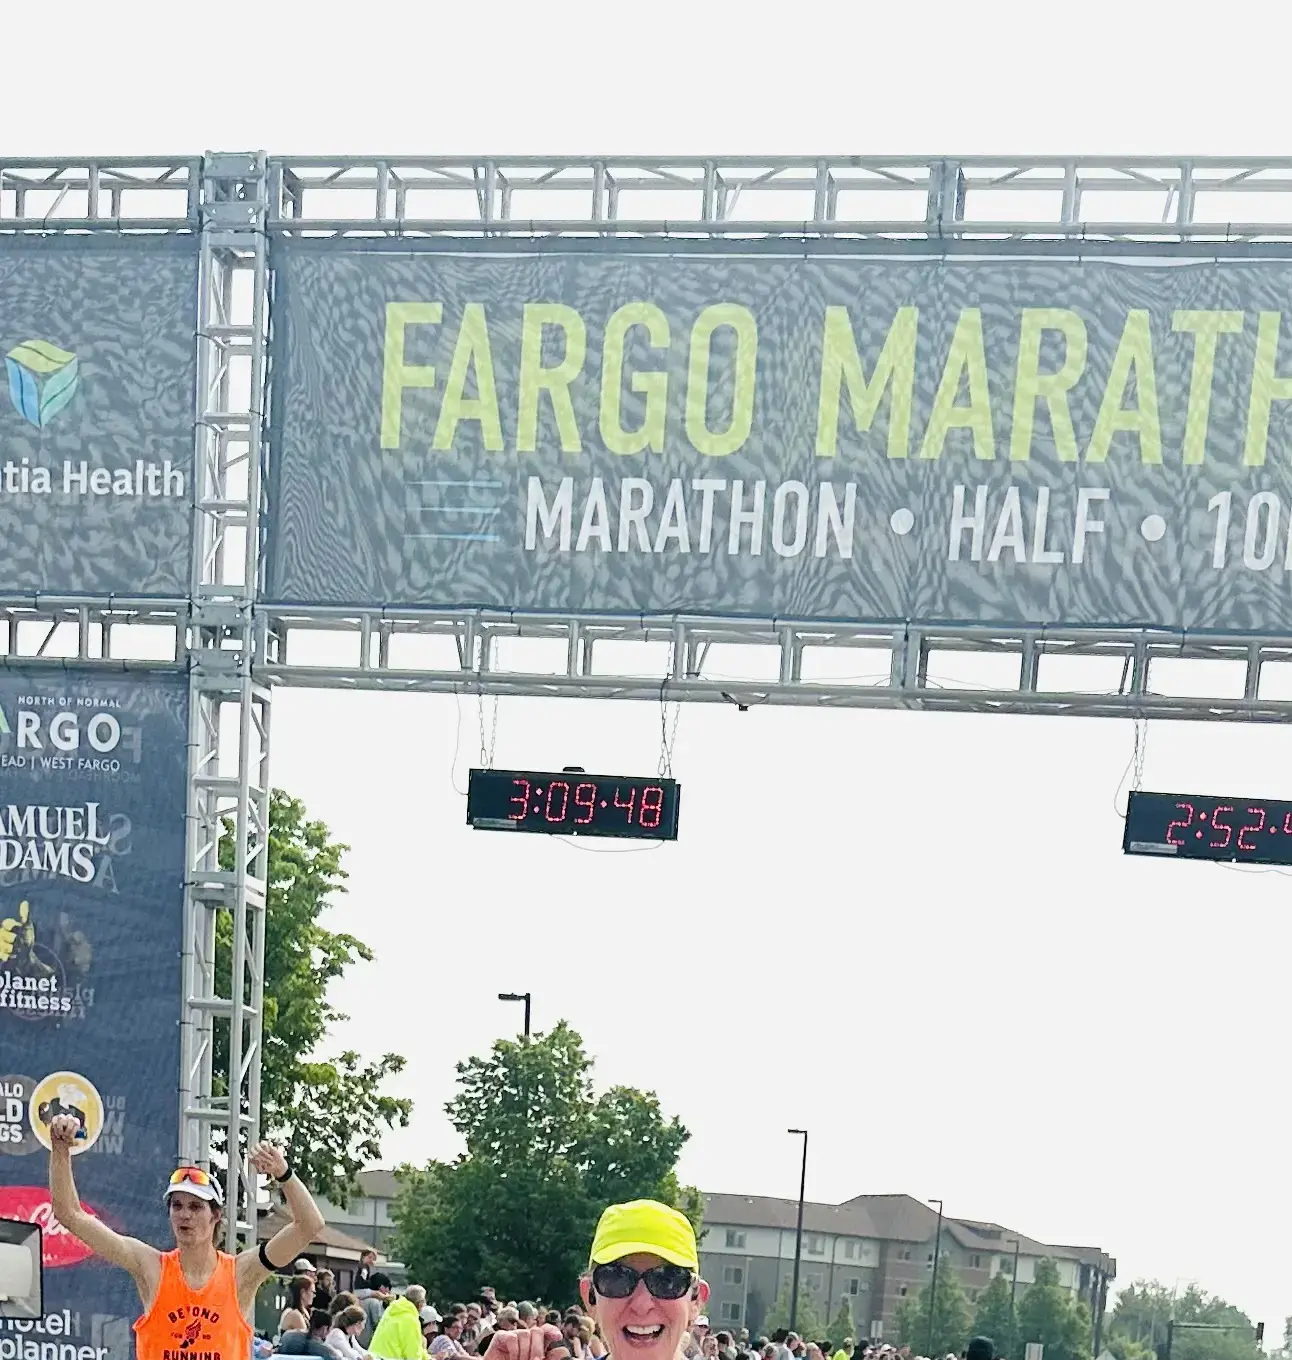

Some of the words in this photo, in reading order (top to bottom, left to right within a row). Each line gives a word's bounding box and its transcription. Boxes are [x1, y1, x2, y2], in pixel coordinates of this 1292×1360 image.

[380, 302, 758, 457] FARGO
[816, 305, 1292, 466] MARATH
[0, 457, 51, 494] tia
[63, 460, 184, 496] Health
[524, 475, 857, 559] MARATHON
[948, 484, 1110, 565] HALF
[1207, 490, 1292, 571] 10
[18, 696, 55, 705] NORTH
[59, 697, 72, 706] OF
[76, 698, 121, 708] NORMAL
[41, 757, 74, 769] WEST
[78, 759, 120, 772] FARGO
[0, 988, 71, 1012] fitness
